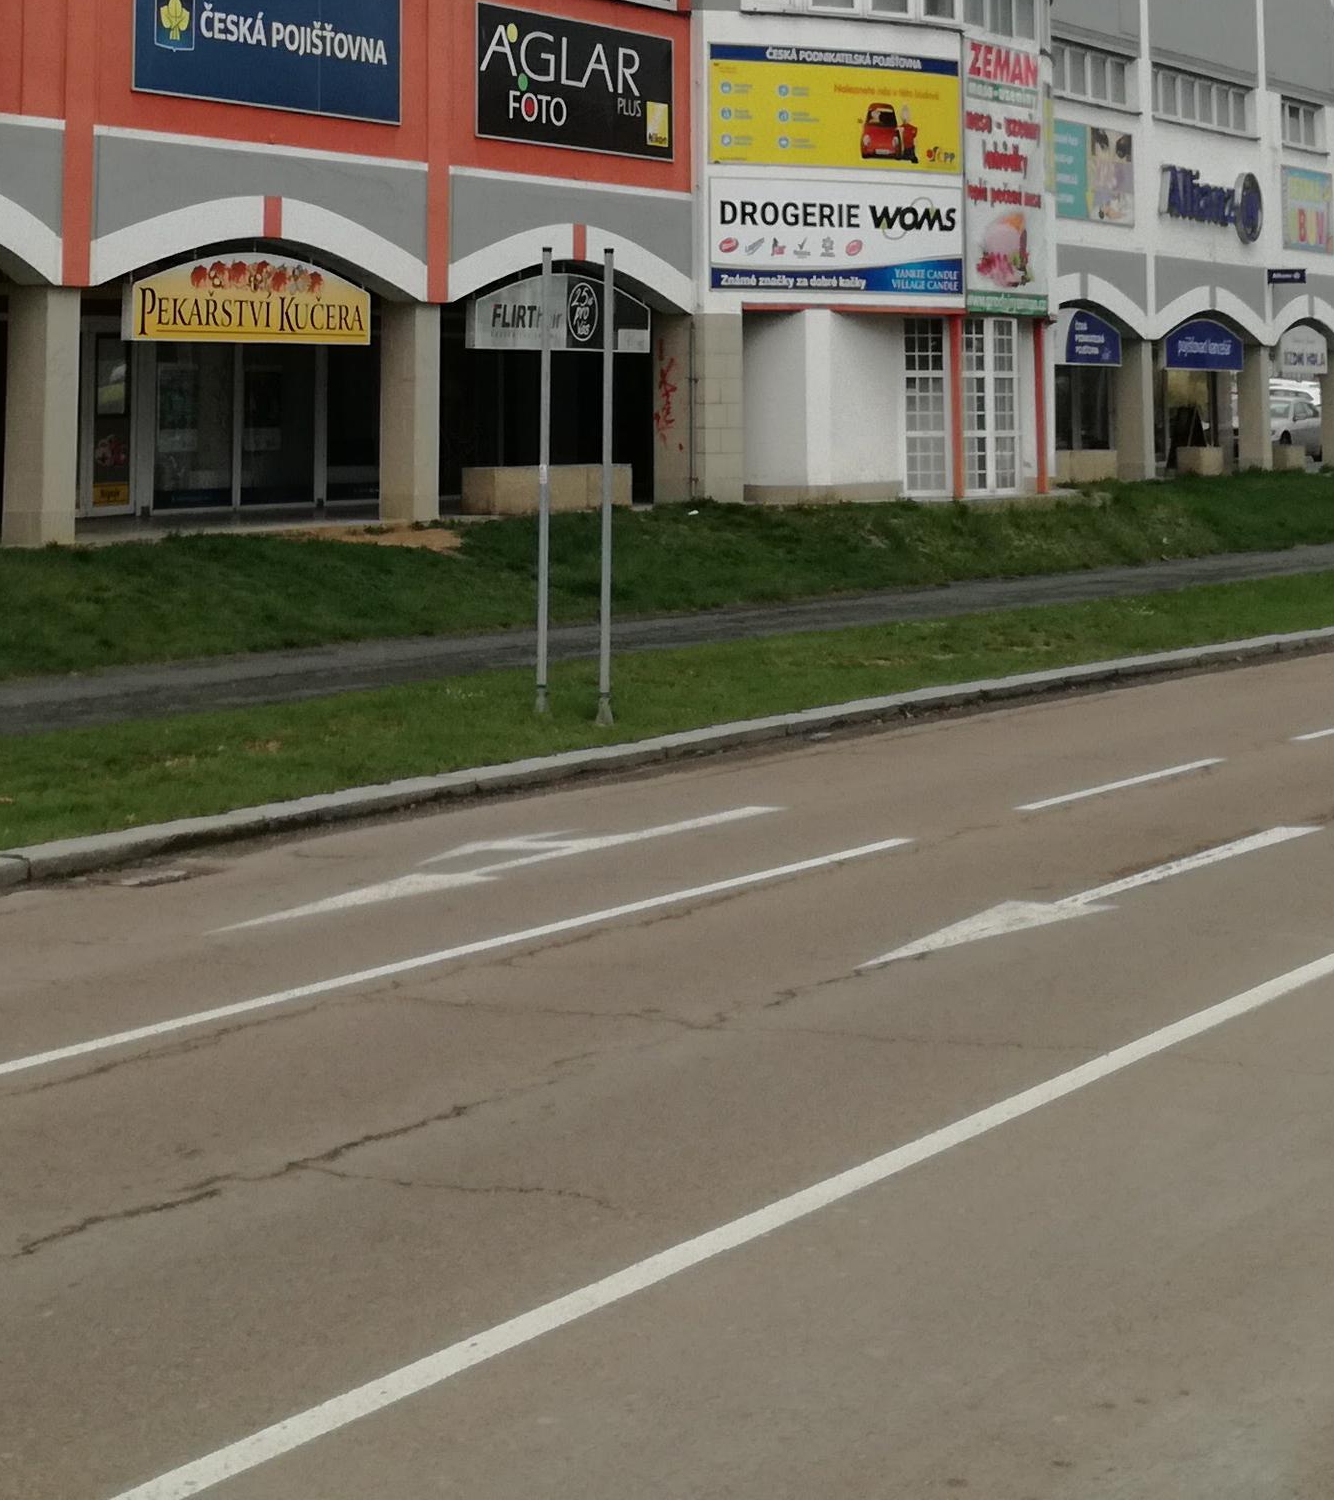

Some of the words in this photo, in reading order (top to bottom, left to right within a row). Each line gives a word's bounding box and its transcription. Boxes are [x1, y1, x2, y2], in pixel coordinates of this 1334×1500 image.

[199, 1, 267, 47] ČESKÁ
[271, 20, 388, 66] POJIŠŤOVNA
[479, 23, 641, 97] AGLAR
[765, 46, 798, 61] ČESKÁ
[968, 42, 1038, 88] ZEMAN
[508, 90, 568, 127] FOTO
[617, 97, 642, 118] PLUS
[719, 200, 861, 229] DROGERIE
[891, 279, 925, 290] VILLAGE
[926, 280, 959, 291] CANDLE
[894, 268, 925, 279] YANKEE
[926, 269, 959, 280] CANDLE
